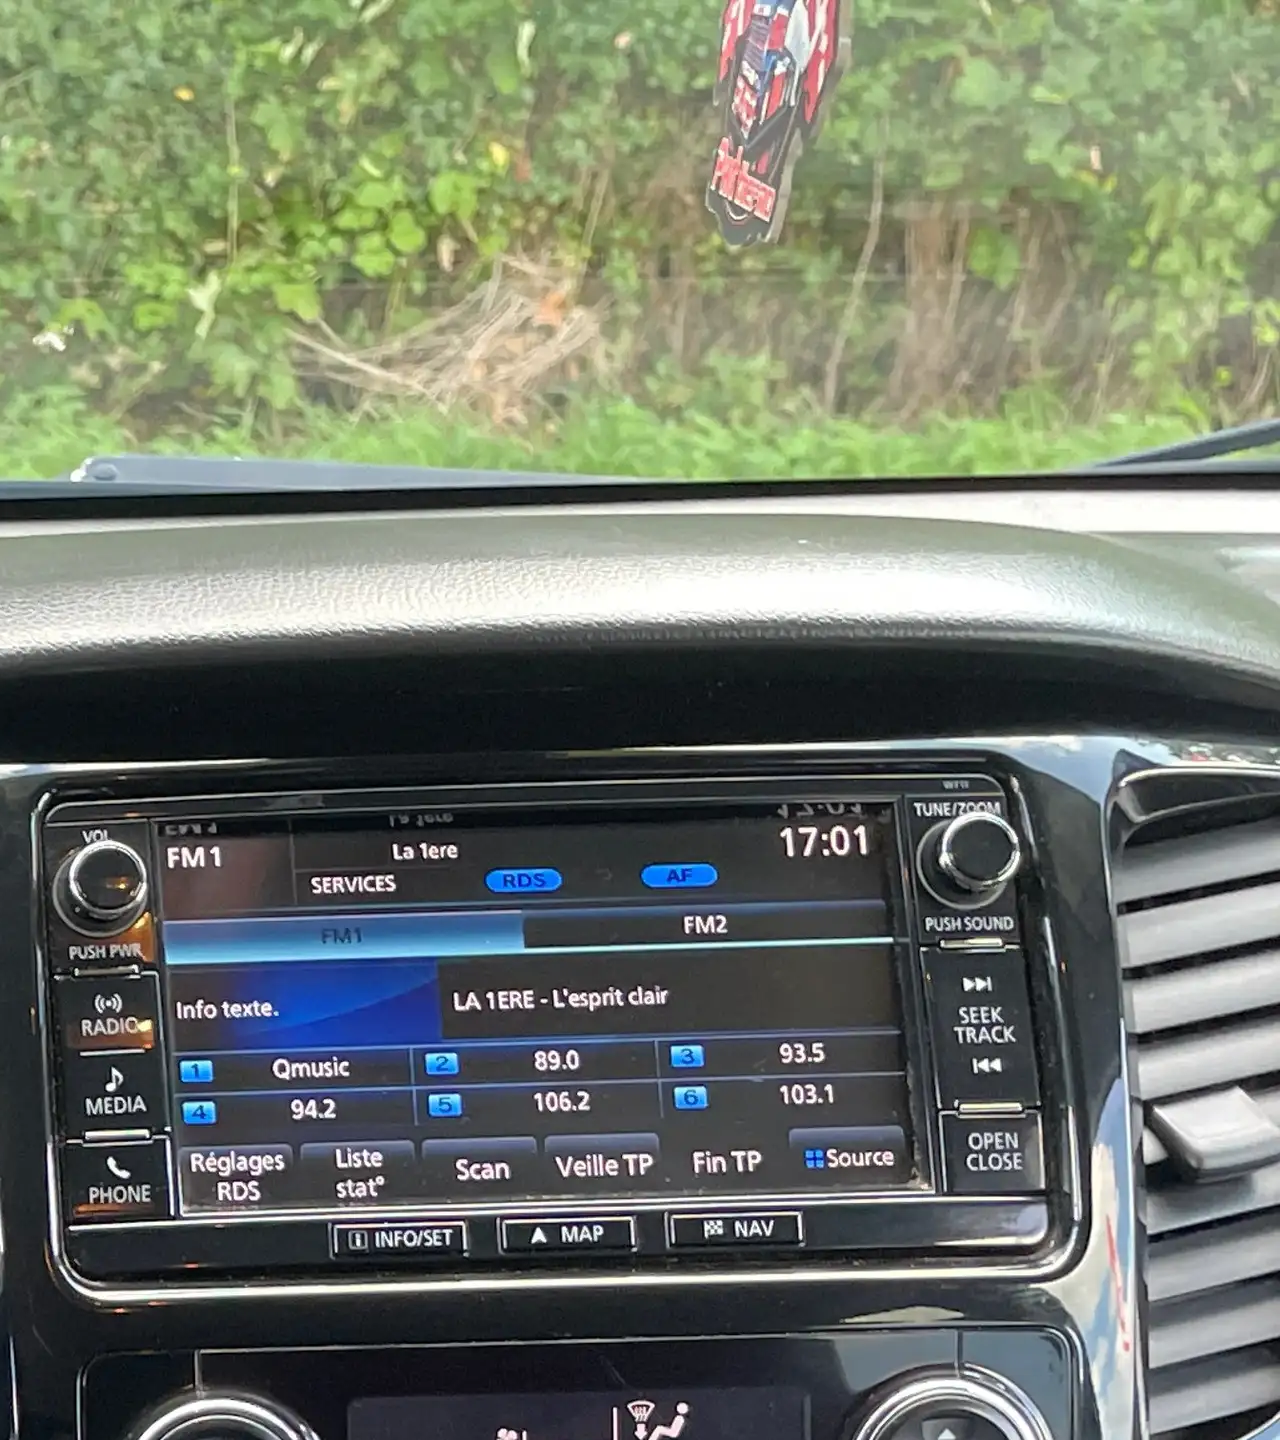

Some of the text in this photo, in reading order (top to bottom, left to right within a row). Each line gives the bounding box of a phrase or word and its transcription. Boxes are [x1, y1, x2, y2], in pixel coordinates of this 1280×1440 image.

[914, 801, 1001, 817] TUNE/ZOOM
[780, 825, 868, 857] 17:01
[392, 842, 458, 860] La 1ere
[311, 875, 397, 894] SERVICES
[503, 873, 546, 888] RDS
[667, 868, 694, 884] AF
[683, 916, 728, 934] FM2
[925, 916, 1014, 932] PUSH SOUND
[321, 928, 363, 943] FM1
[69, 942, 145, 960] PUSH PWR
[453, 993, 481, 1011] LA
[485, 991, 535, 1010] 1ERE
[553, 988, 624, 1010] L'esprit
[628, 987, 668, 1006] clair
[176, 1000, 280, 1019] Info texte.
[959, 1007, 1004, 1024] SEEK
[81, 1019, 139, 1036] RADIO
[954, 1026, 1015, 1044] TRACK
[436, 1050, 579, 1071] 2 89.0
[681, 1043, 826, 1063] 3 93.5
[191, 1058, 350, 1080] 1 Qmusic
[439, 1091, 591, 1113] 5 106.2
[683, 1084, 835, 1105] 6 103.1
[86, 1097, 146, 1115] MEDIA
[191, 1099, 336, 1120] 4 94.2
[968, 1133, 1019, 1150] OPEN
[190, 1151, 285, 1175] Réglages
[336, 1149, 383, 1168] Liste
[555, 1153, 653, 1177] Veille TP
[693, 1150, 761, 1172] Fin TP
[827, 1147, 894, 1167] Source
[967, 1153, 1023, 1172] CLOSE
[456, 1159, 510, 1180] Scan
[89, 1186, 151, 1203] PHONE
[217, 1181, 260, 1200] RDS
[561, 1225, 604, 1242] MAP
[735, 1219, 774, 1237] NAV
[374, 1229, 453, 1249] INFO/SET
